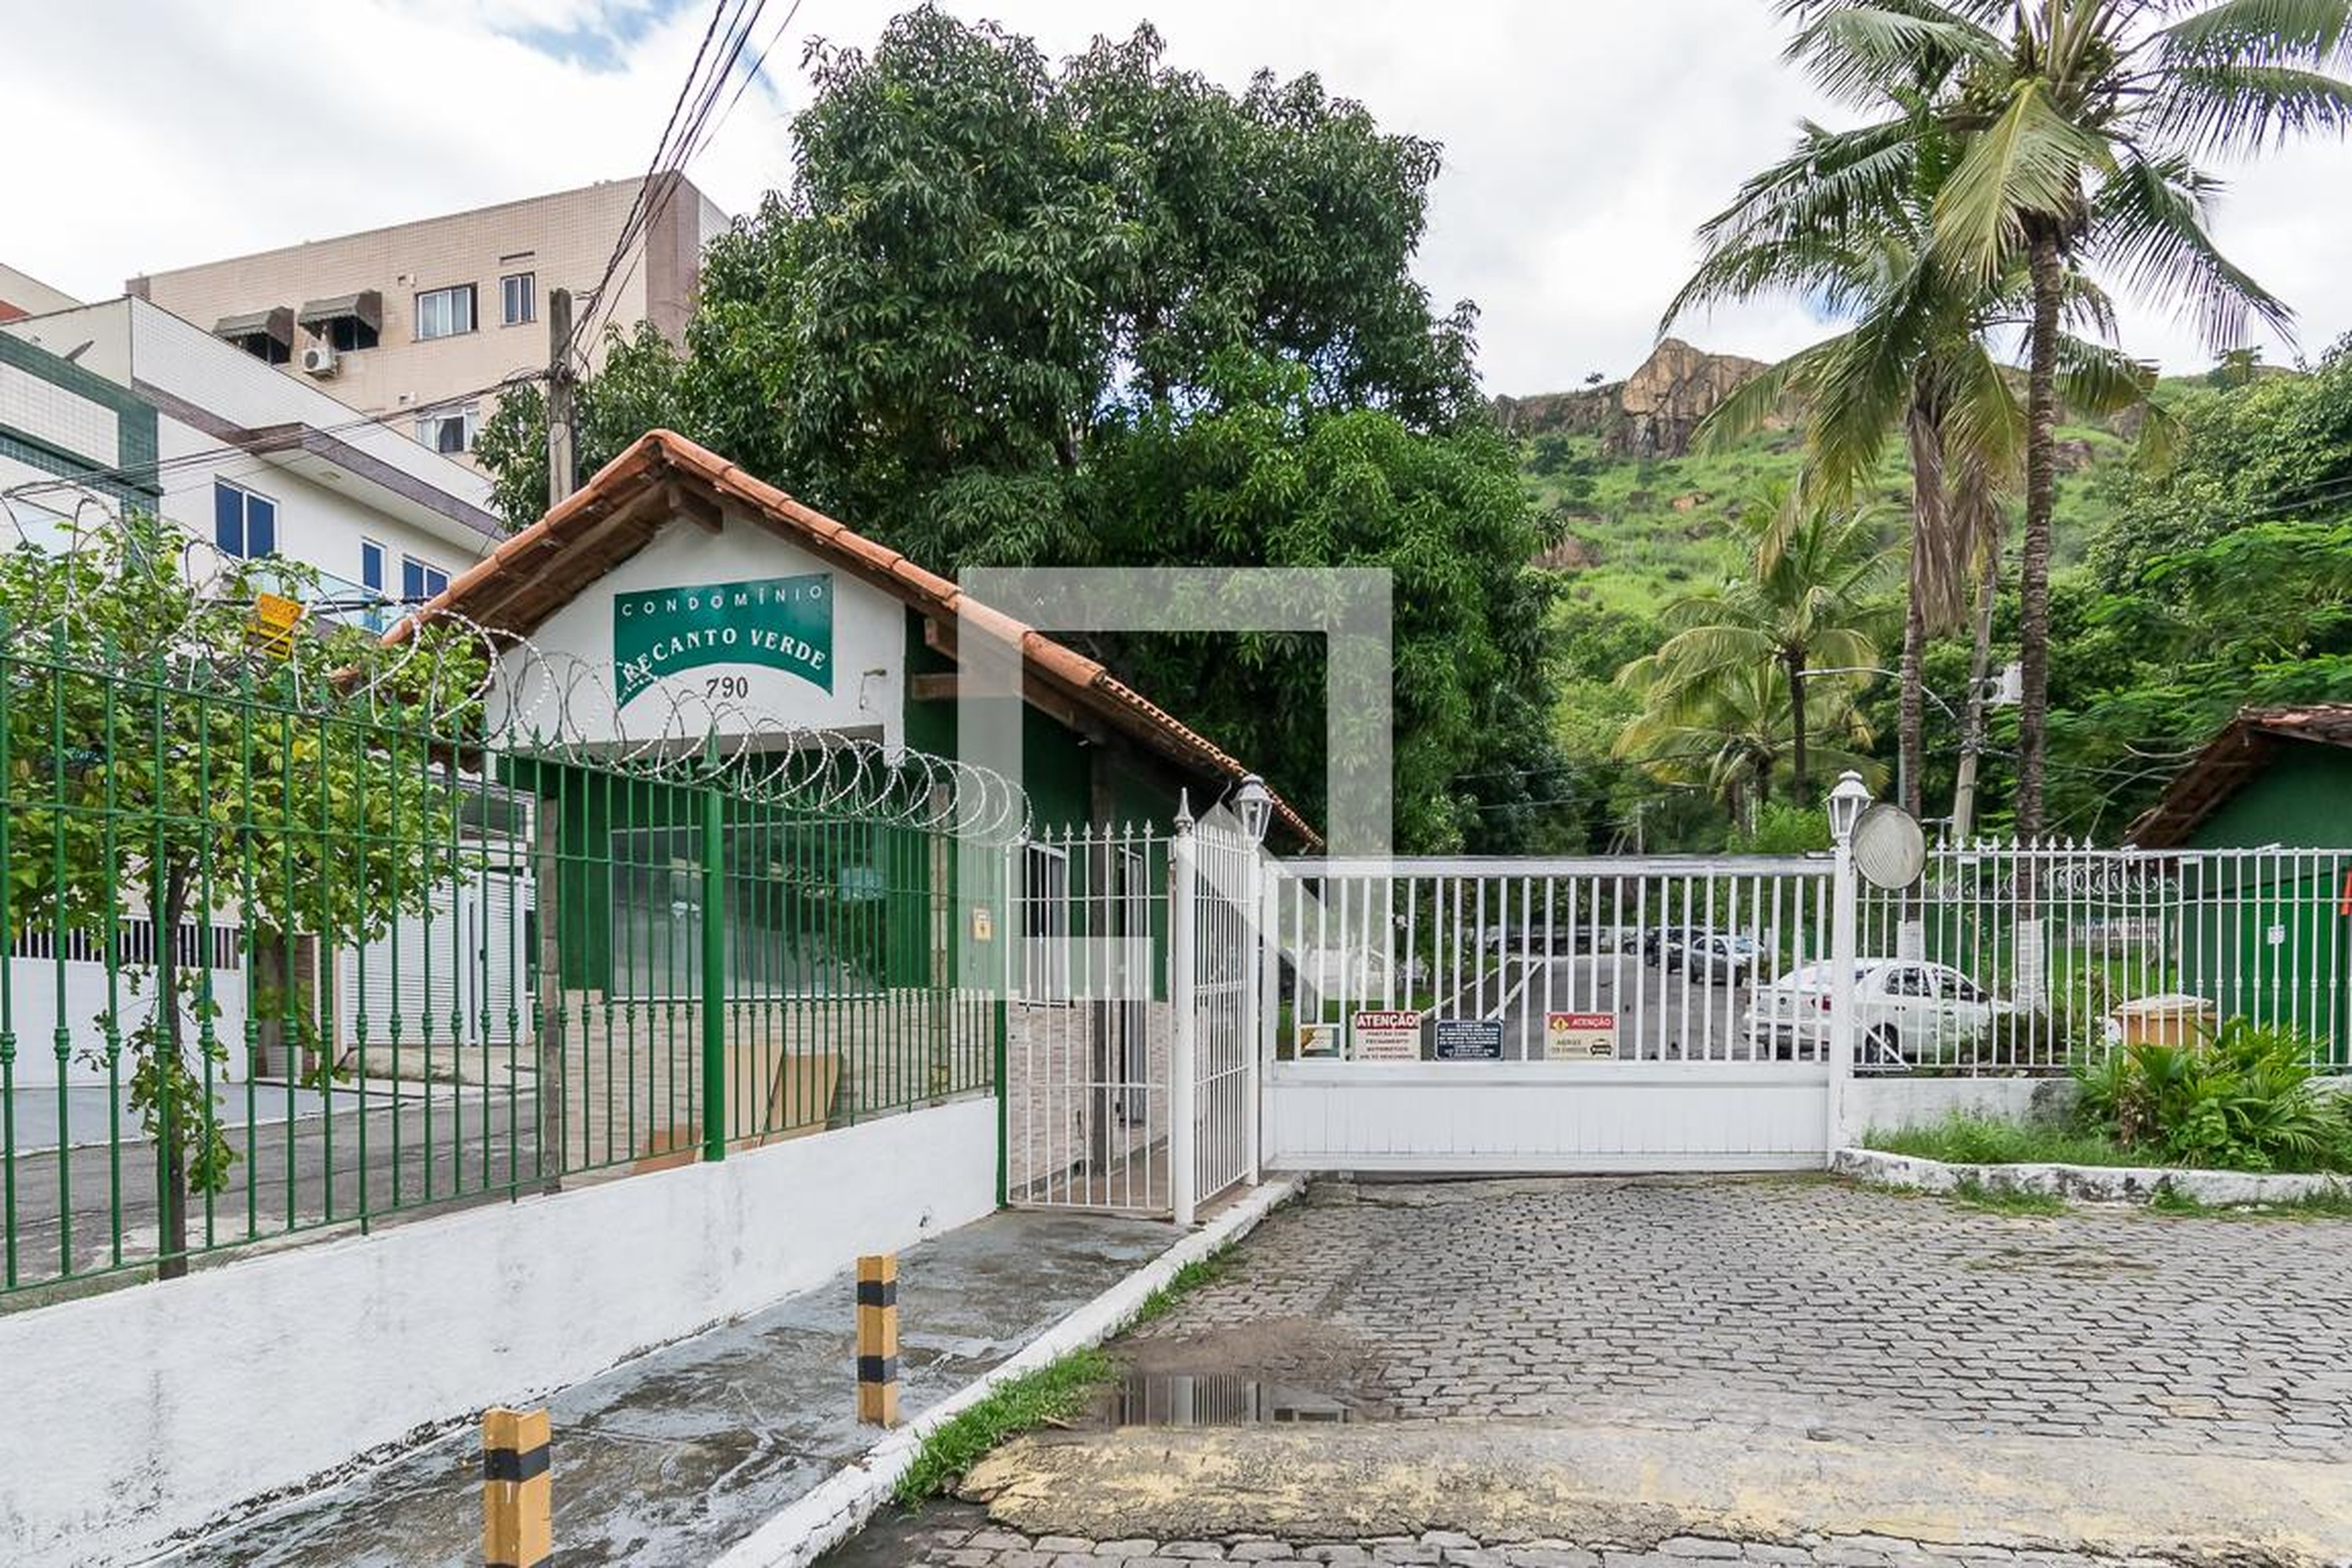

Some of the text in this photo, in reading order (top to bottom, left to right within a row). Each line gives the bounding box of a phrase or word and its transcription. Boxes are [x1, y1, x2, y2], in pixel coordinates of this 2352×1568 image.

[622, 585, 823, 617] CONDOMÍNIO
[622, 627, 826, 682] RECANTO VERDE
[706, 676, 748, 699] 790
